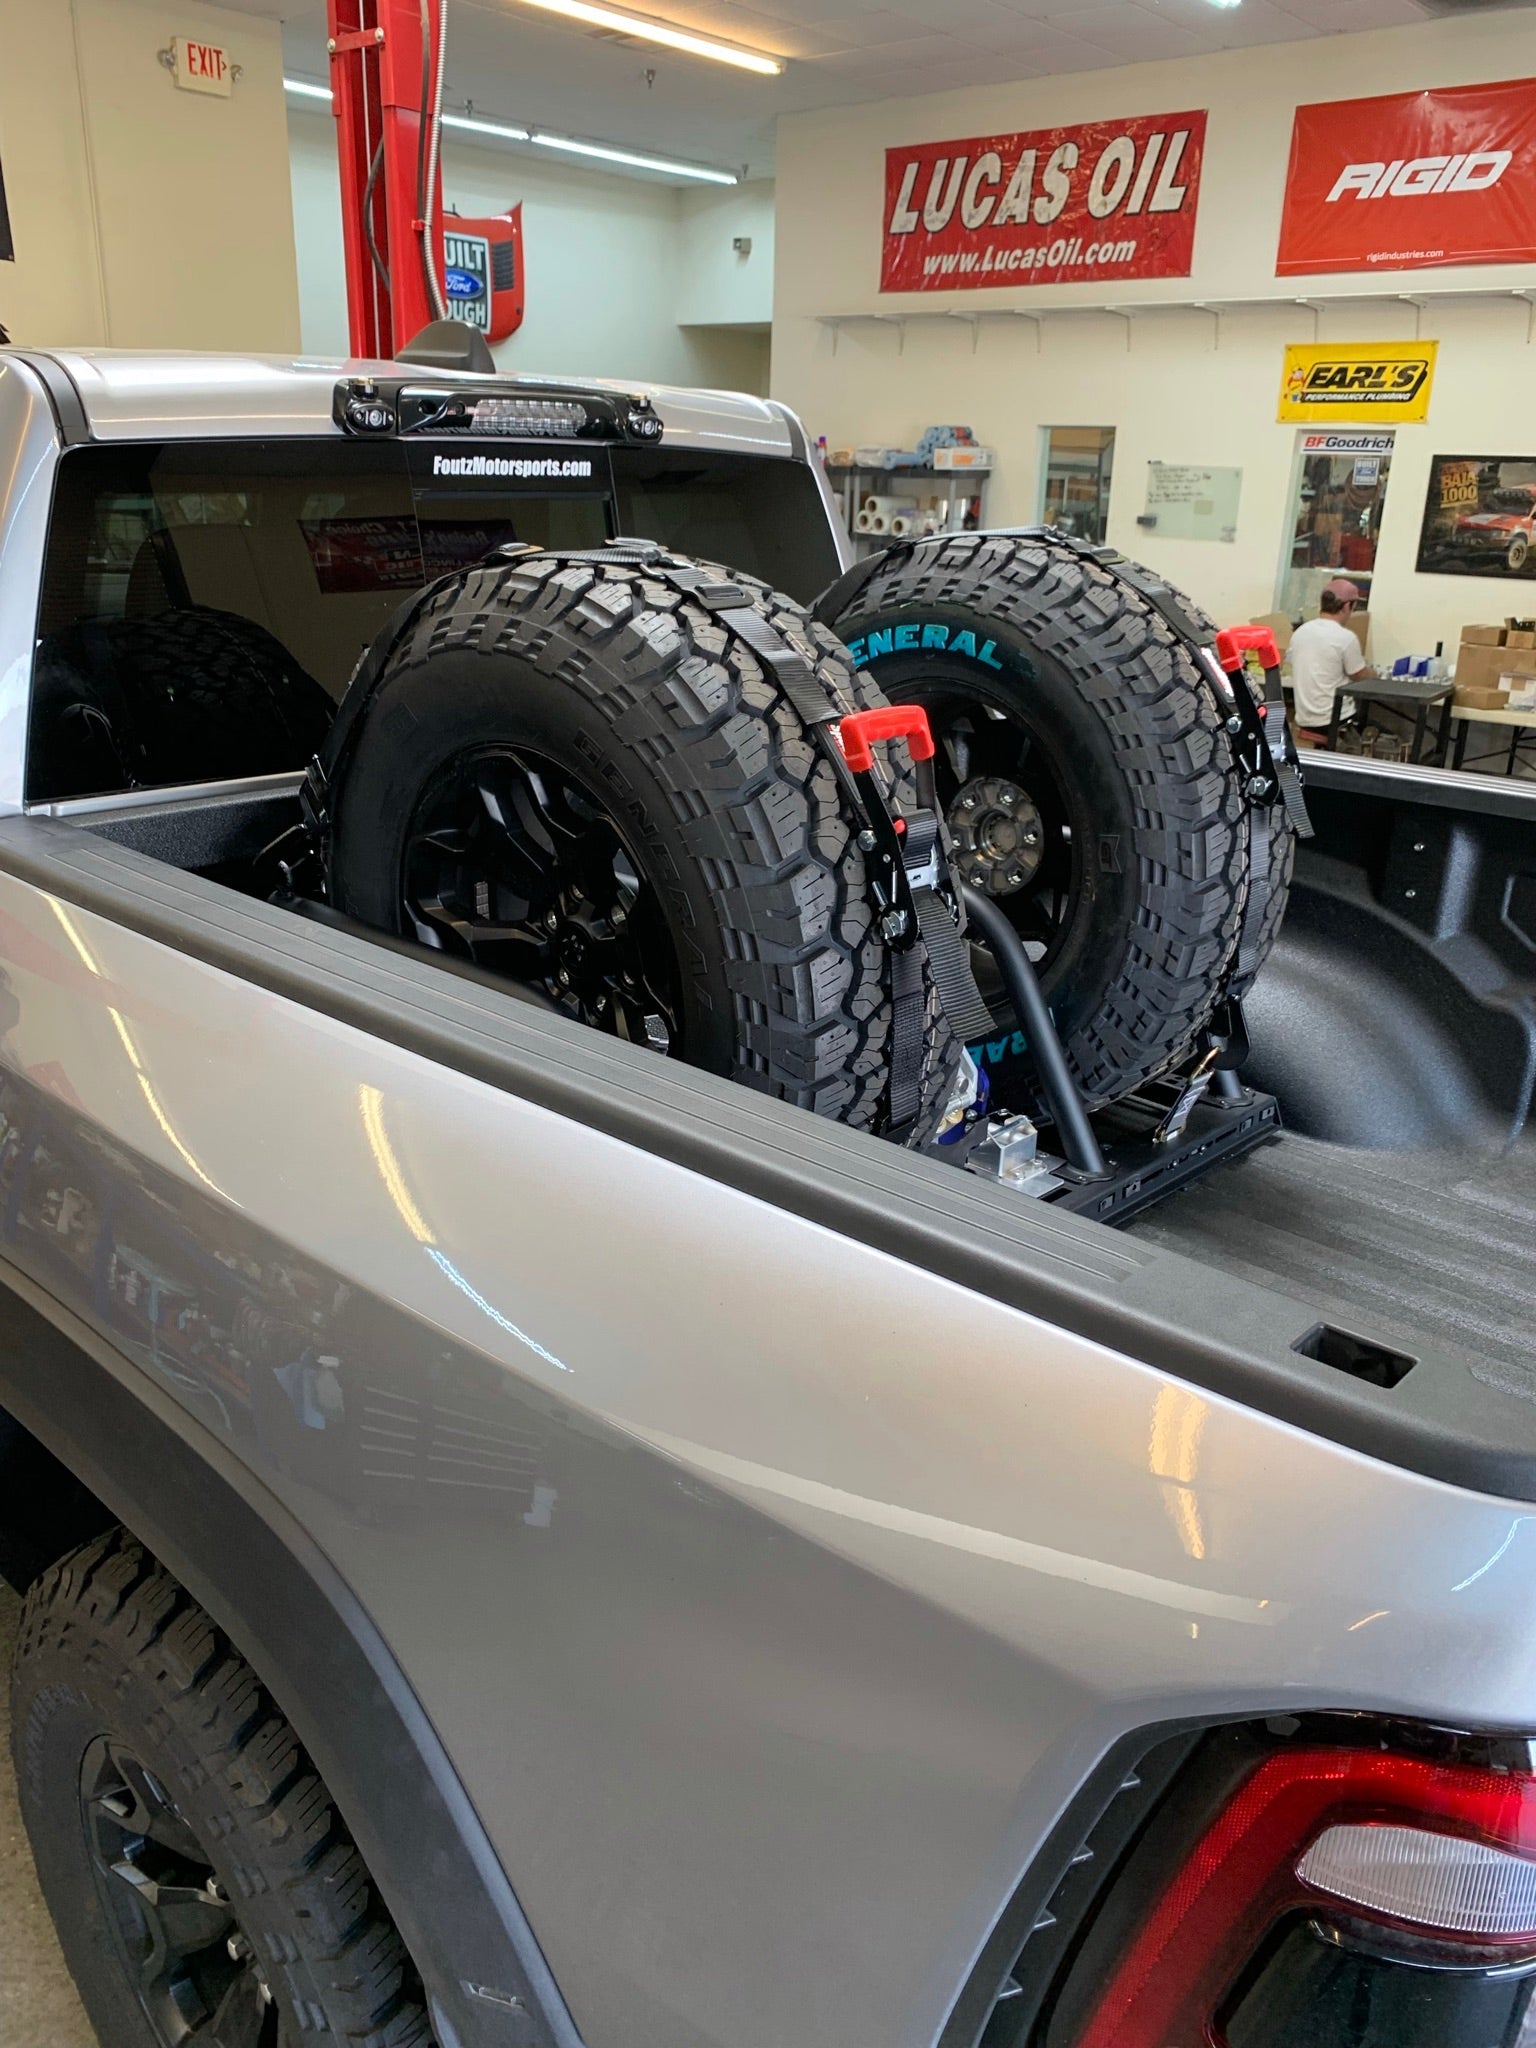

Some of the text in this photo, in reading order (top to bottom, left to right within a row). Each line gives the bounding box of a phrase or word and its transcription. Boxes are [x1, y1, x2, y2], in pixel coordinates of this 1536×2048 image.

[187, 42, 222, 80] EXIT
[888, 129, 1191, 235] LUCAS OIL
[1325, 150, 1513, 203] RIGID
[445, 240, 484, 270] UILT
[923, 237, 1137, 276] www.LucasOil.com
[1366, 249, 1444, 263] rigidindustries.com
[446, 299, 487, 326] OUGH
[1306, 364, 1420, 390] EARL'S
[1305, 392, 1412, 402] PERFORMANCE PLUMBING
[1304, 435, 1395, 449] BFGoodrich
[433, 455, 592, 478] FoutzMotorsports.com
[1441, 471, 1477, 489] BAJA
[1441, 485, 1478, 502] 1000
[847, 624, 1003, 670] ENERAL
